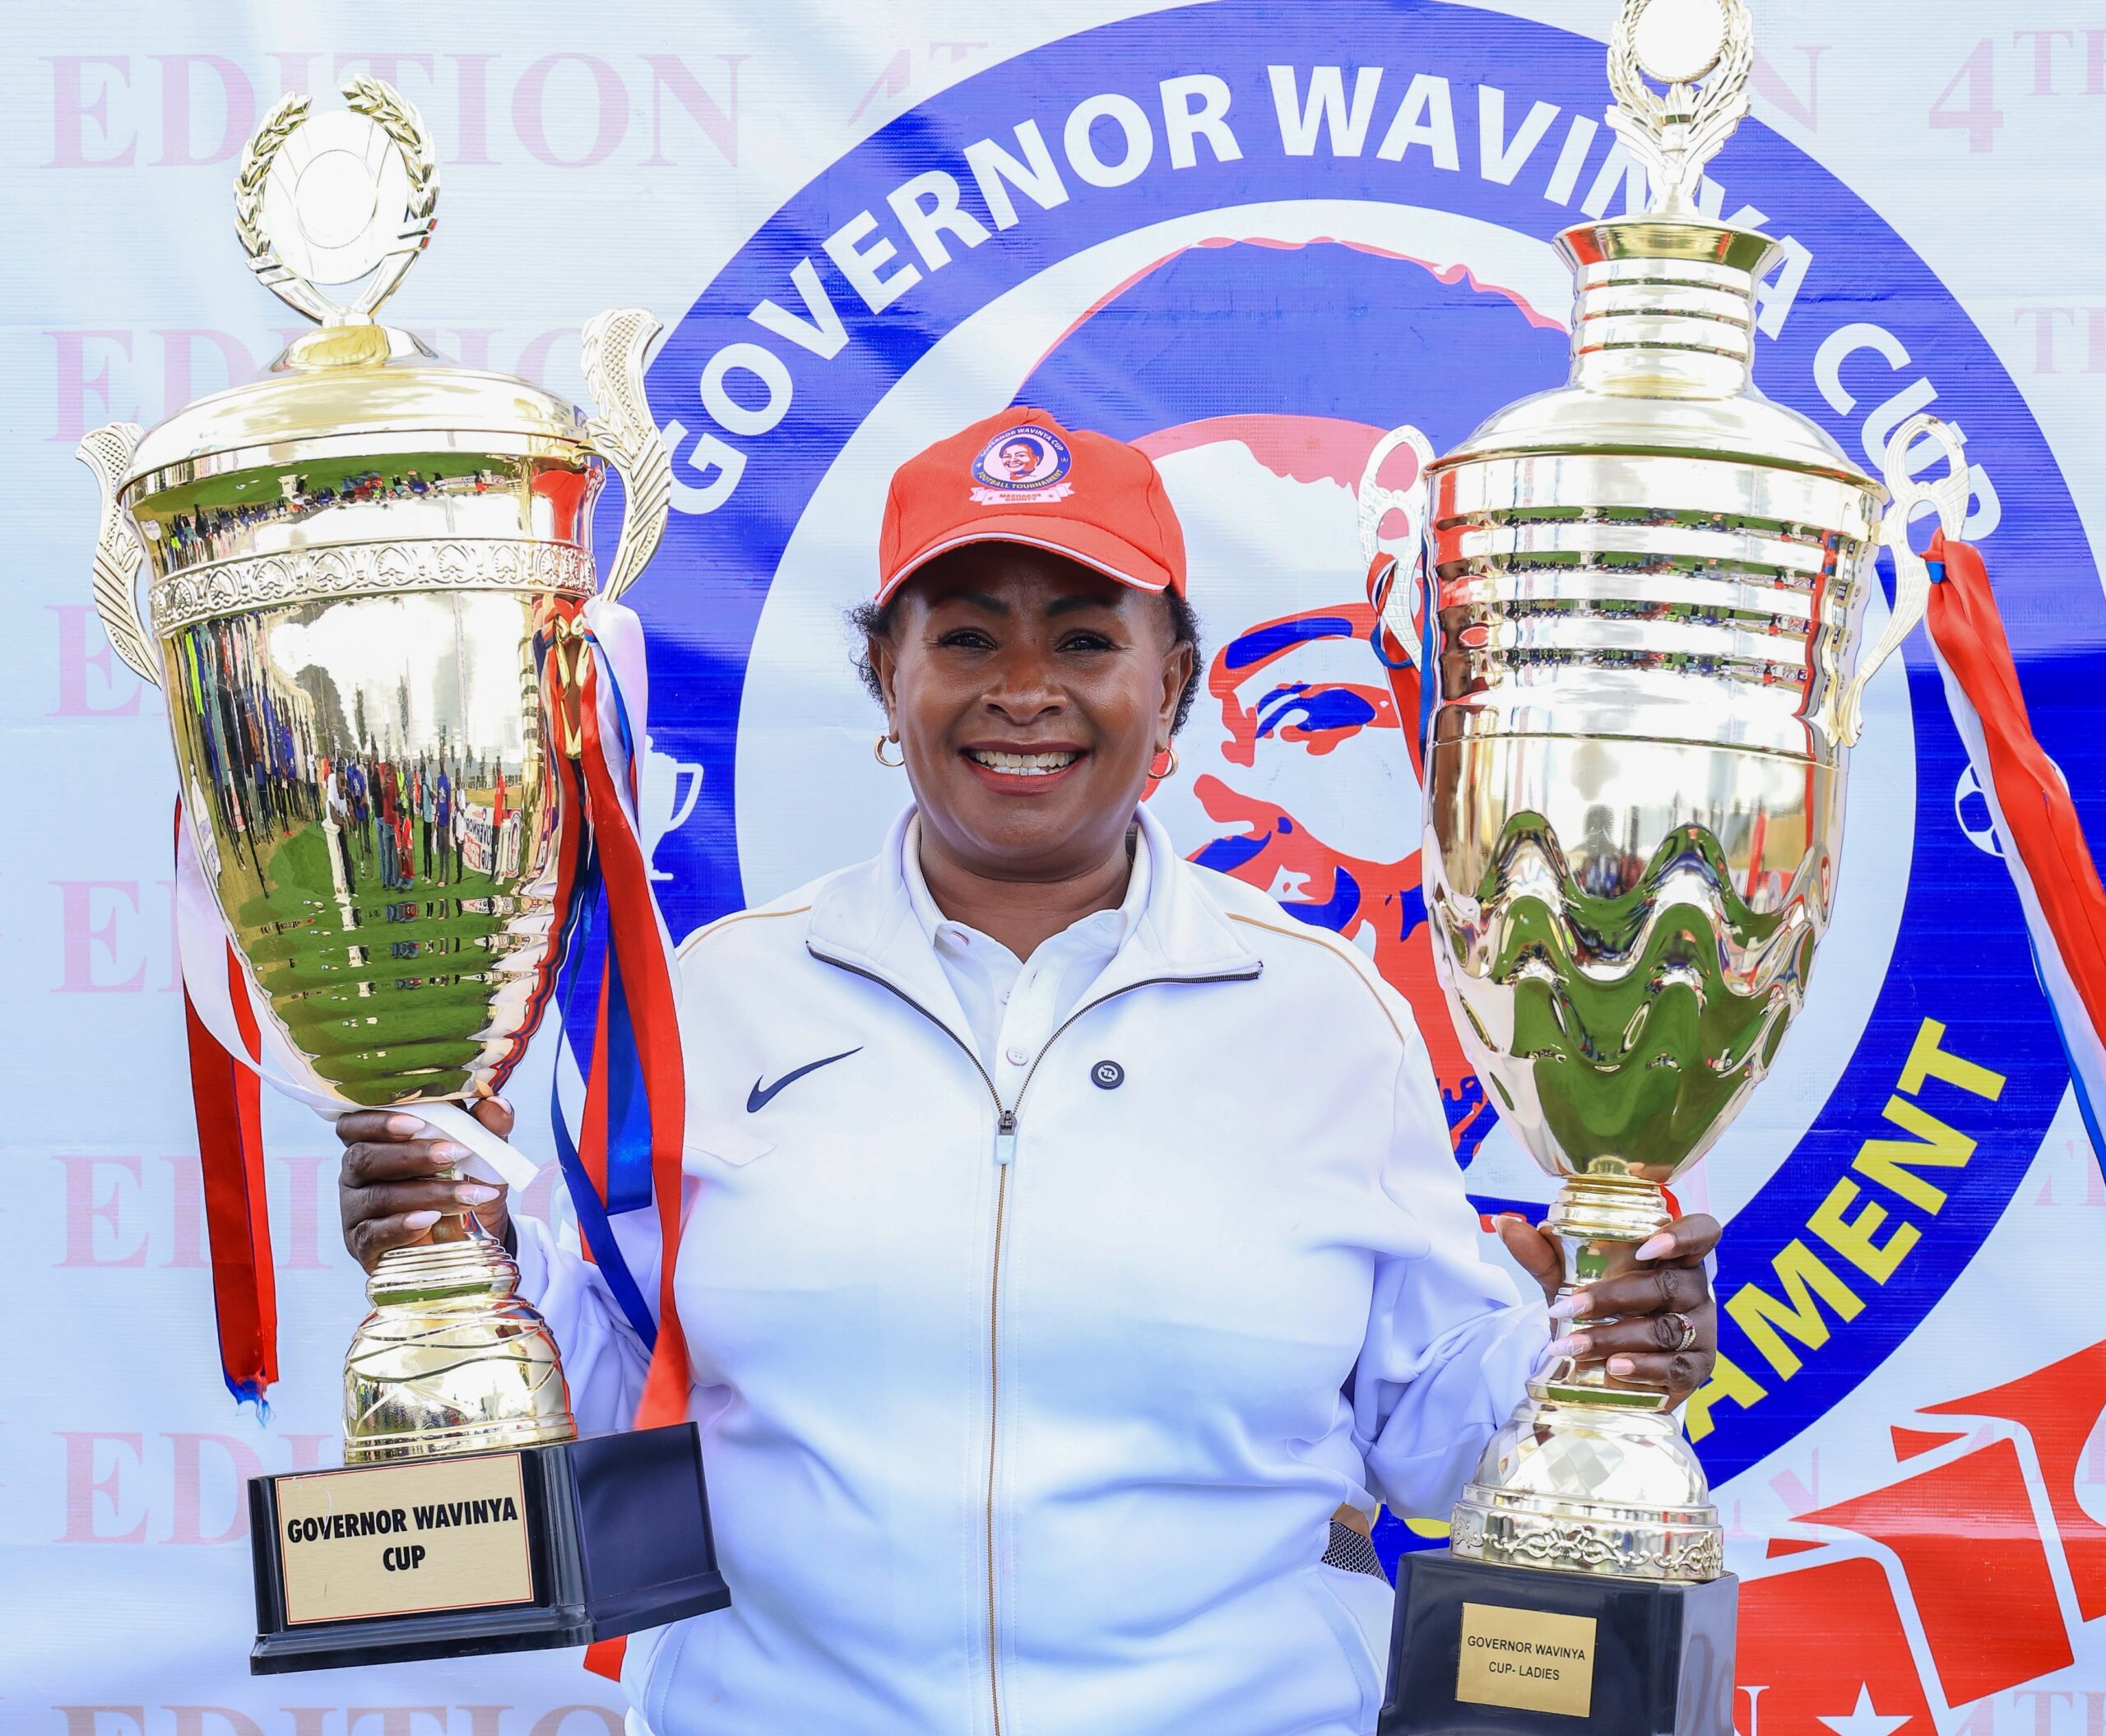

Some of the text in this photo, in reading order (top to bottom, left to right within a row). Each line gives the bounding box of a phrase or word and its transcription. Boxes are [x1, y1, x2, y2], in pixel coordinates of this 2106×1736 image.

[661, 73, 1244, 516] GOVERNOR
[980, 427, 1064, 457] GOVERNOR WAVINYA CUP
[977, 469, 1063, 490] FOOTBALL TOURNAMENT
[288, 1497, 518, 1543] GOVERNOR WAVINYA
[383, 1545, 425, 1571] CUP
[1468, 1636, 1585, 1660] GOVERNOR WAVINYA
[1488, 1661, 1560, 1680] CUP- LADIES
